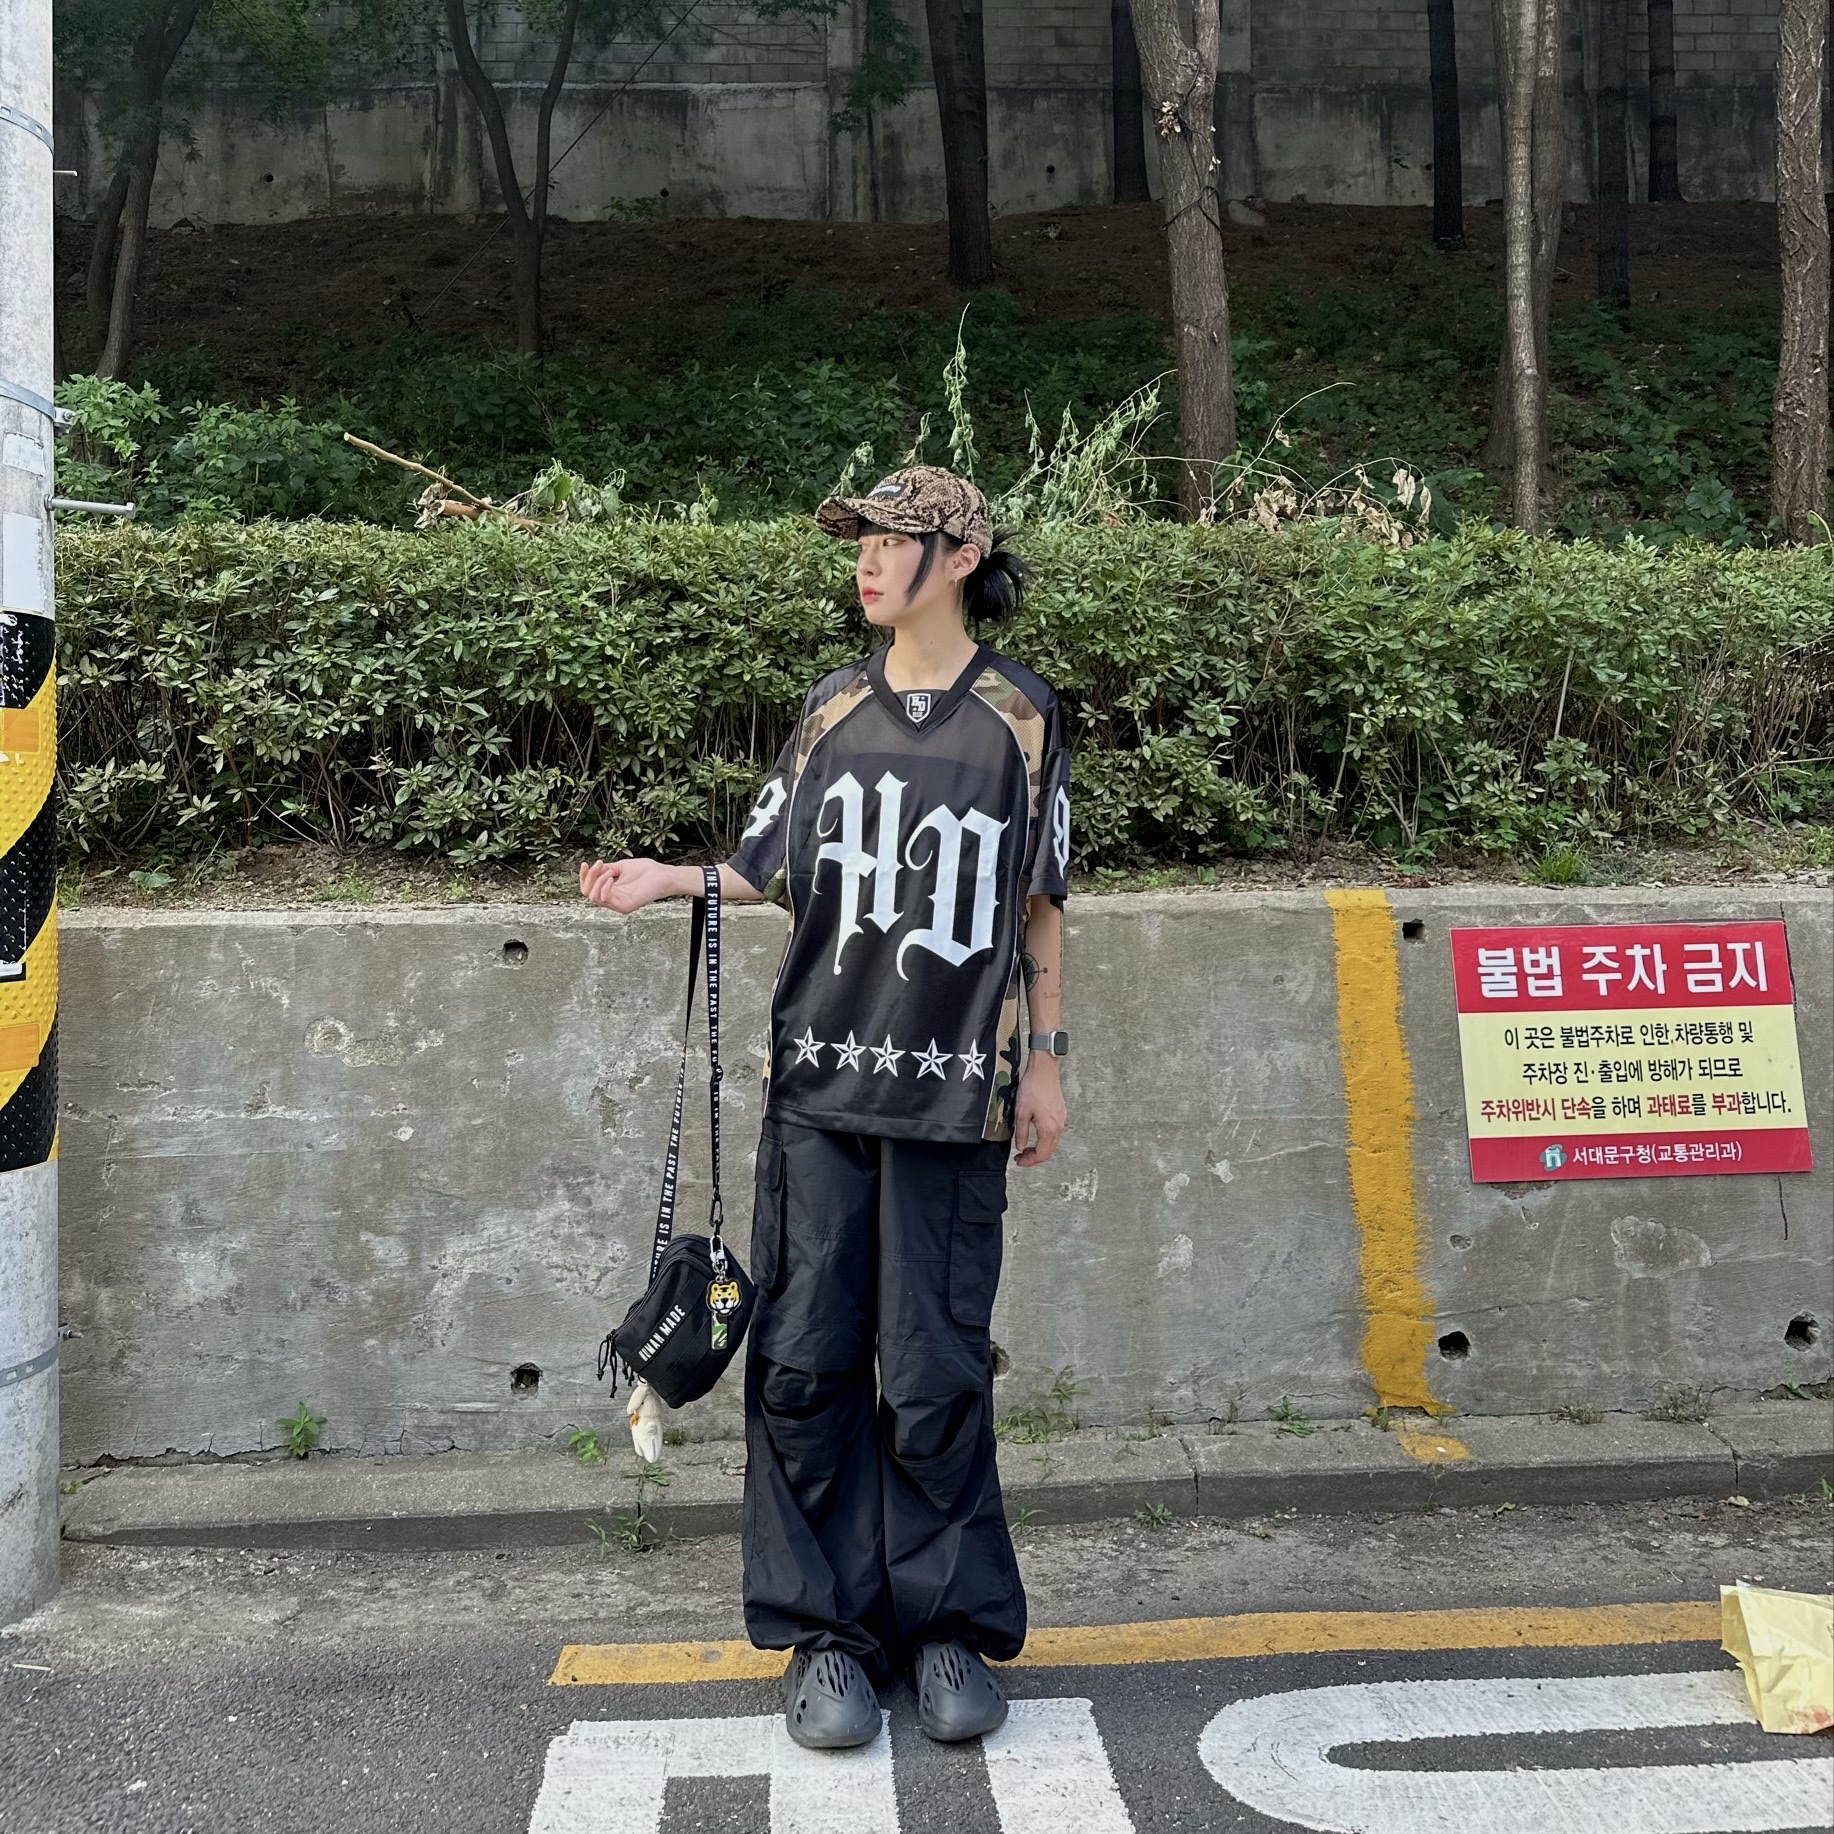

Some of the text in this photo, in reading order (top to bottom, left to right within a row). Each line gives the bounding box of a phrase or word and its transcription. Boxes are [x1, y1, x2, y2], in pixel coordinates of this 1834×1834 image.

[706, 870, 718, 888] THE
[707, 893, 718, 933] FUTURE
[708, 938, 718, 948] IS
[708, 954, 718, 965] IN
[1476, 940, 1769, 999] 불법 주차 금지
[709, 970, 718, 988] THE
[709, 993, 718, 1018] PAST
[1504, 1026, 1520, 1050] 이
[1524, 1026, 1555, 1050] 곳은
[1560, 1024, 1636, 1049] 불법주차로
[1675, 1021, 1734, 1046] 차량통행
[1738, 1020, 1754, 1043] 및
[1522, 1061, 1568, 1085] 주차장
[1648, 1058, 1693, 1082] 방해가
[1698, 1057, 1743, 1080] 되므로
[1480, 1091, 1792, 1123] 주차위반시 단속을 하며 과태료를 부과합니다.
[669, 1127, 679, 1148] THE
[665, 1152, 677, 1180] PAST
[662, 1182, 674, 1202] THE
[660, 1206, 672, 1219] IN
[658, 1222, 670, 1234] IS
[659, 1304, 686, 1336] MADE
